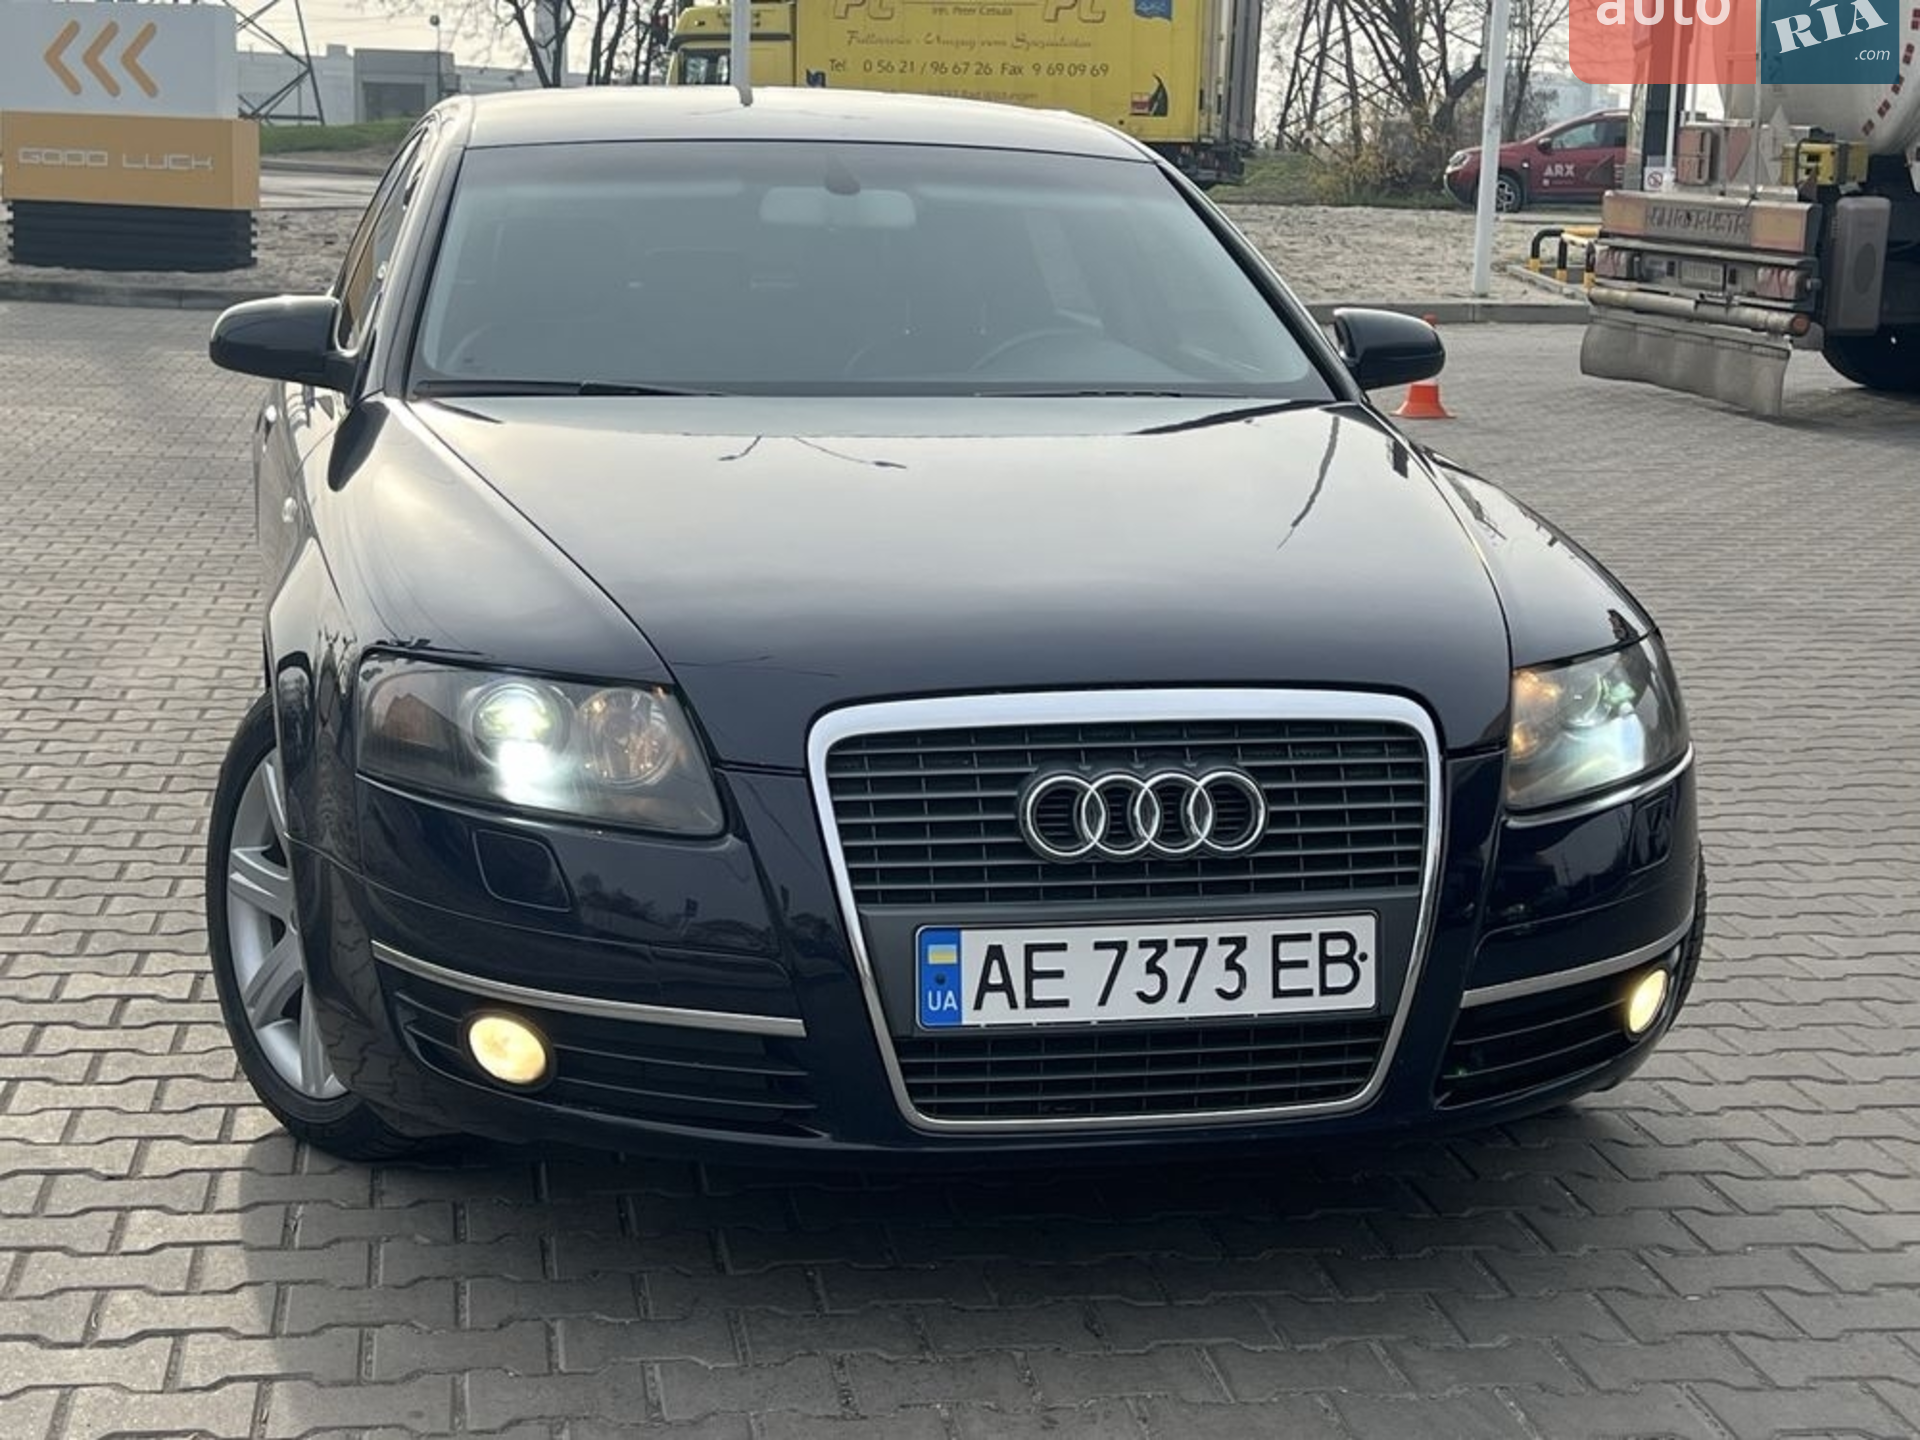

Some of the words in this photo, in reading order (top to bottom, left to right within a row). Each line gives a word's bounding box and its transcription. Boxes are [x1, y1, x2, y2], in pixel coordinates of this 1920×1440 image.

[877, 60, 895, 74] 56
[900, 60, 915, 74] 21
[930, 60, 949, 75] 96
[952, 61, 971, 76] 67
[974, 61, 993, 76] 26
[1000, 62, 1023, 76] Fax
[18, 147, 109, 167] GOOD
[122, 152, 215, 171] LUCK
[1543, 163, 1576, 178] ARX
[973, 942, 1070, 1010] AE
[1093, 935, 1248, 1006] 7373
[1271, 930, 1362, 999] EB
[928, 989, 959, 1011] UA
